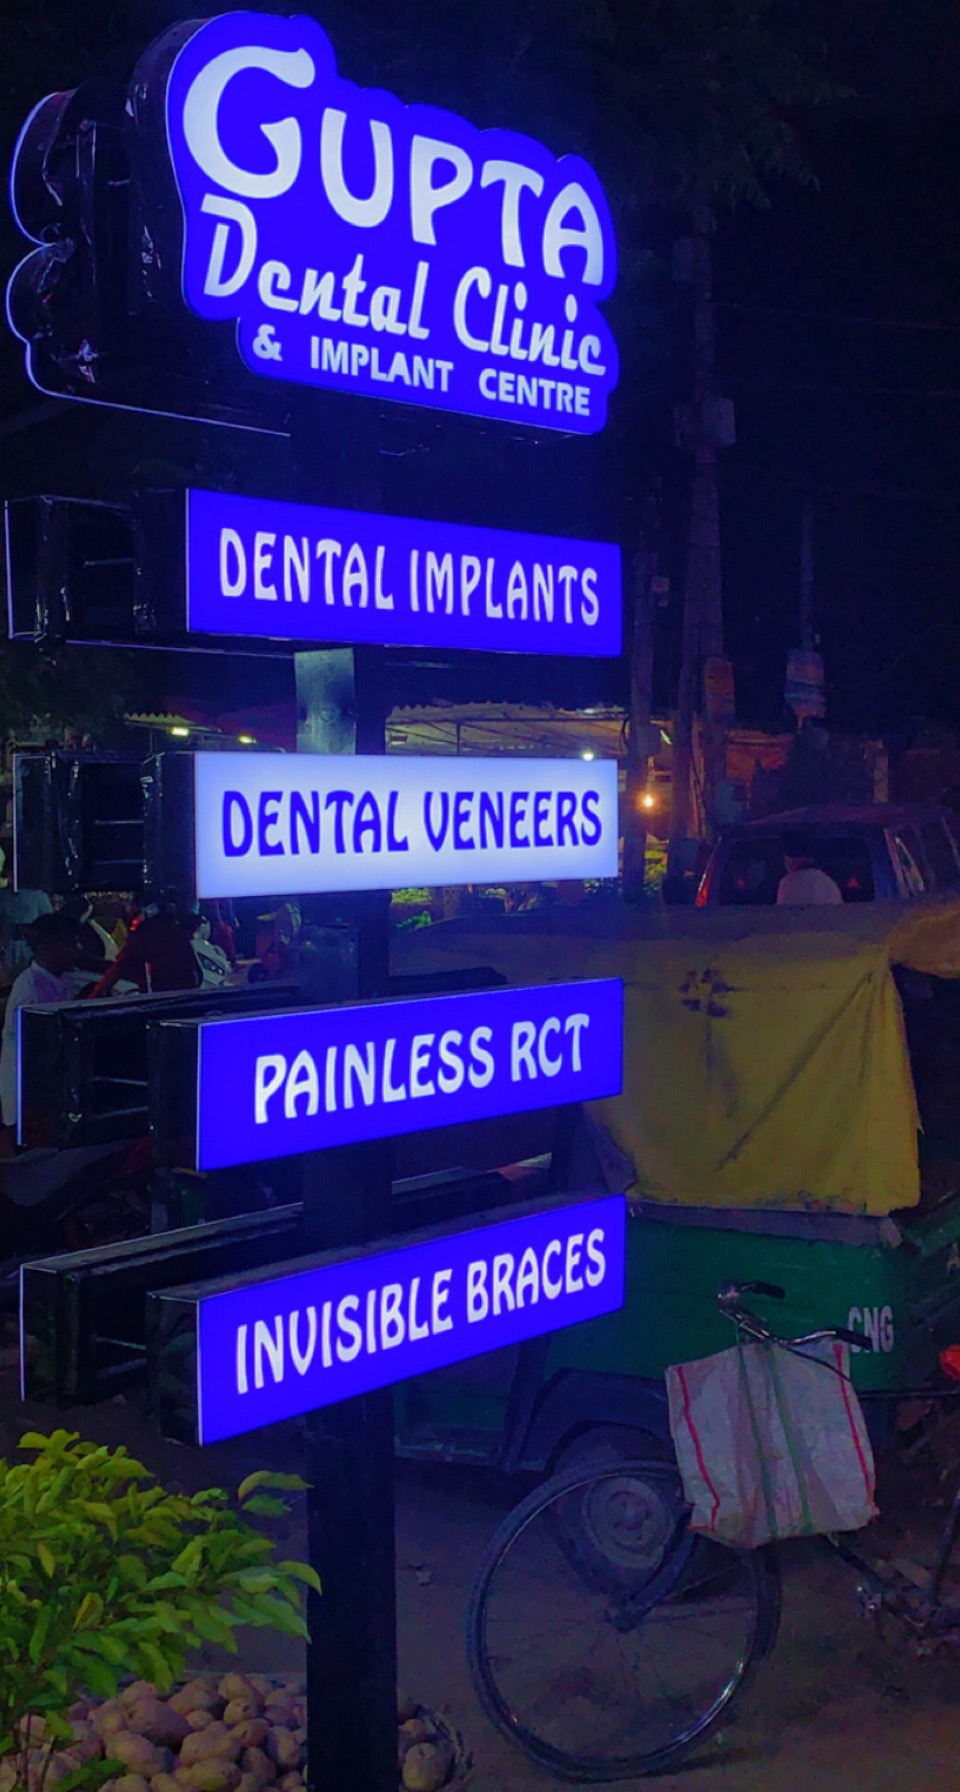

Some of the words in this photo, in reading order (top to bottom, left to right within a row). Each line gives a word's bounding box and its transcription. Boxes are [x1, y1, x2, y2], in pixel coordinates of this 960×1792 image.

[184, 46, 604, 285] GUPTA
[201, 193, 430, 339] Dental
[453, 266, 606, 375] Clinic
[252, 325, 282, 361] &
[310, 336, 453, 391] IMPLANT
[478, 369, 590, 416] CENTRE
[220, 528, 394, 610] DENTAL
[410, 549, 599, 626] IMPLANTS
[222, 790, 409, 857] DENTAL
[423, 790, 602, 852] VENEERS
[254, 1026, 494, 1124] PAINLESS
[511, 1013, 590, 1082] RCT
[236, 1269, 453, 1394] INVISIBLE
[466, 1228, 606, 1324] BRACES
[848, 1305, 895, 1353] CNG
